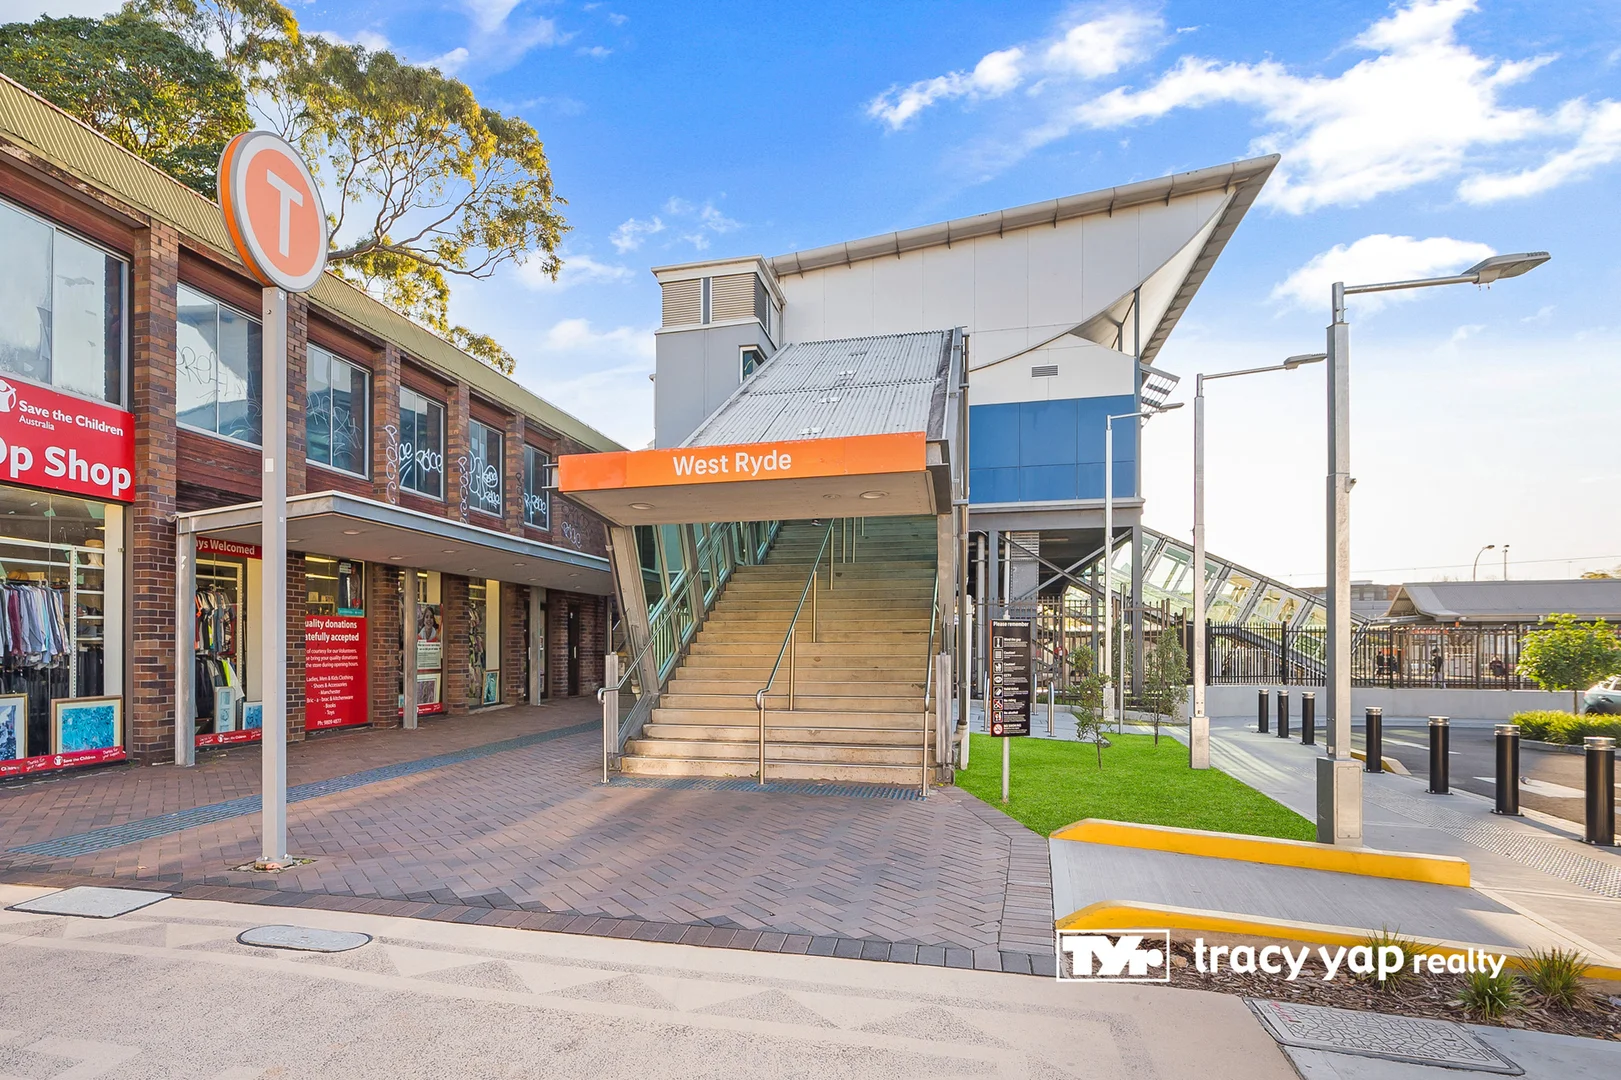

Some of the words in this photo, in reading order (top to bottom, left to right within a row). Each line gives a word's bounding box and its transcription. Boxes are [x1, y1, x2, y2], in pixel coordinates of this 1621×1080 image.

[267, 168, 303, 258] T
[18, 400, 49, 418] Save
[52, 409, 73, 423] the
[75, 415, 124, 436] Children
[18, 415, 55, 431] Australia
[44, 446, 131, 497] Shop
[673, 455, 729, 476] West
[735, 449, 792, 477] Ryde
[209, 539, 255, 555] Welcomed
[325, 619, 358, 629] donations
[331, 632, 360, 643] accepted
